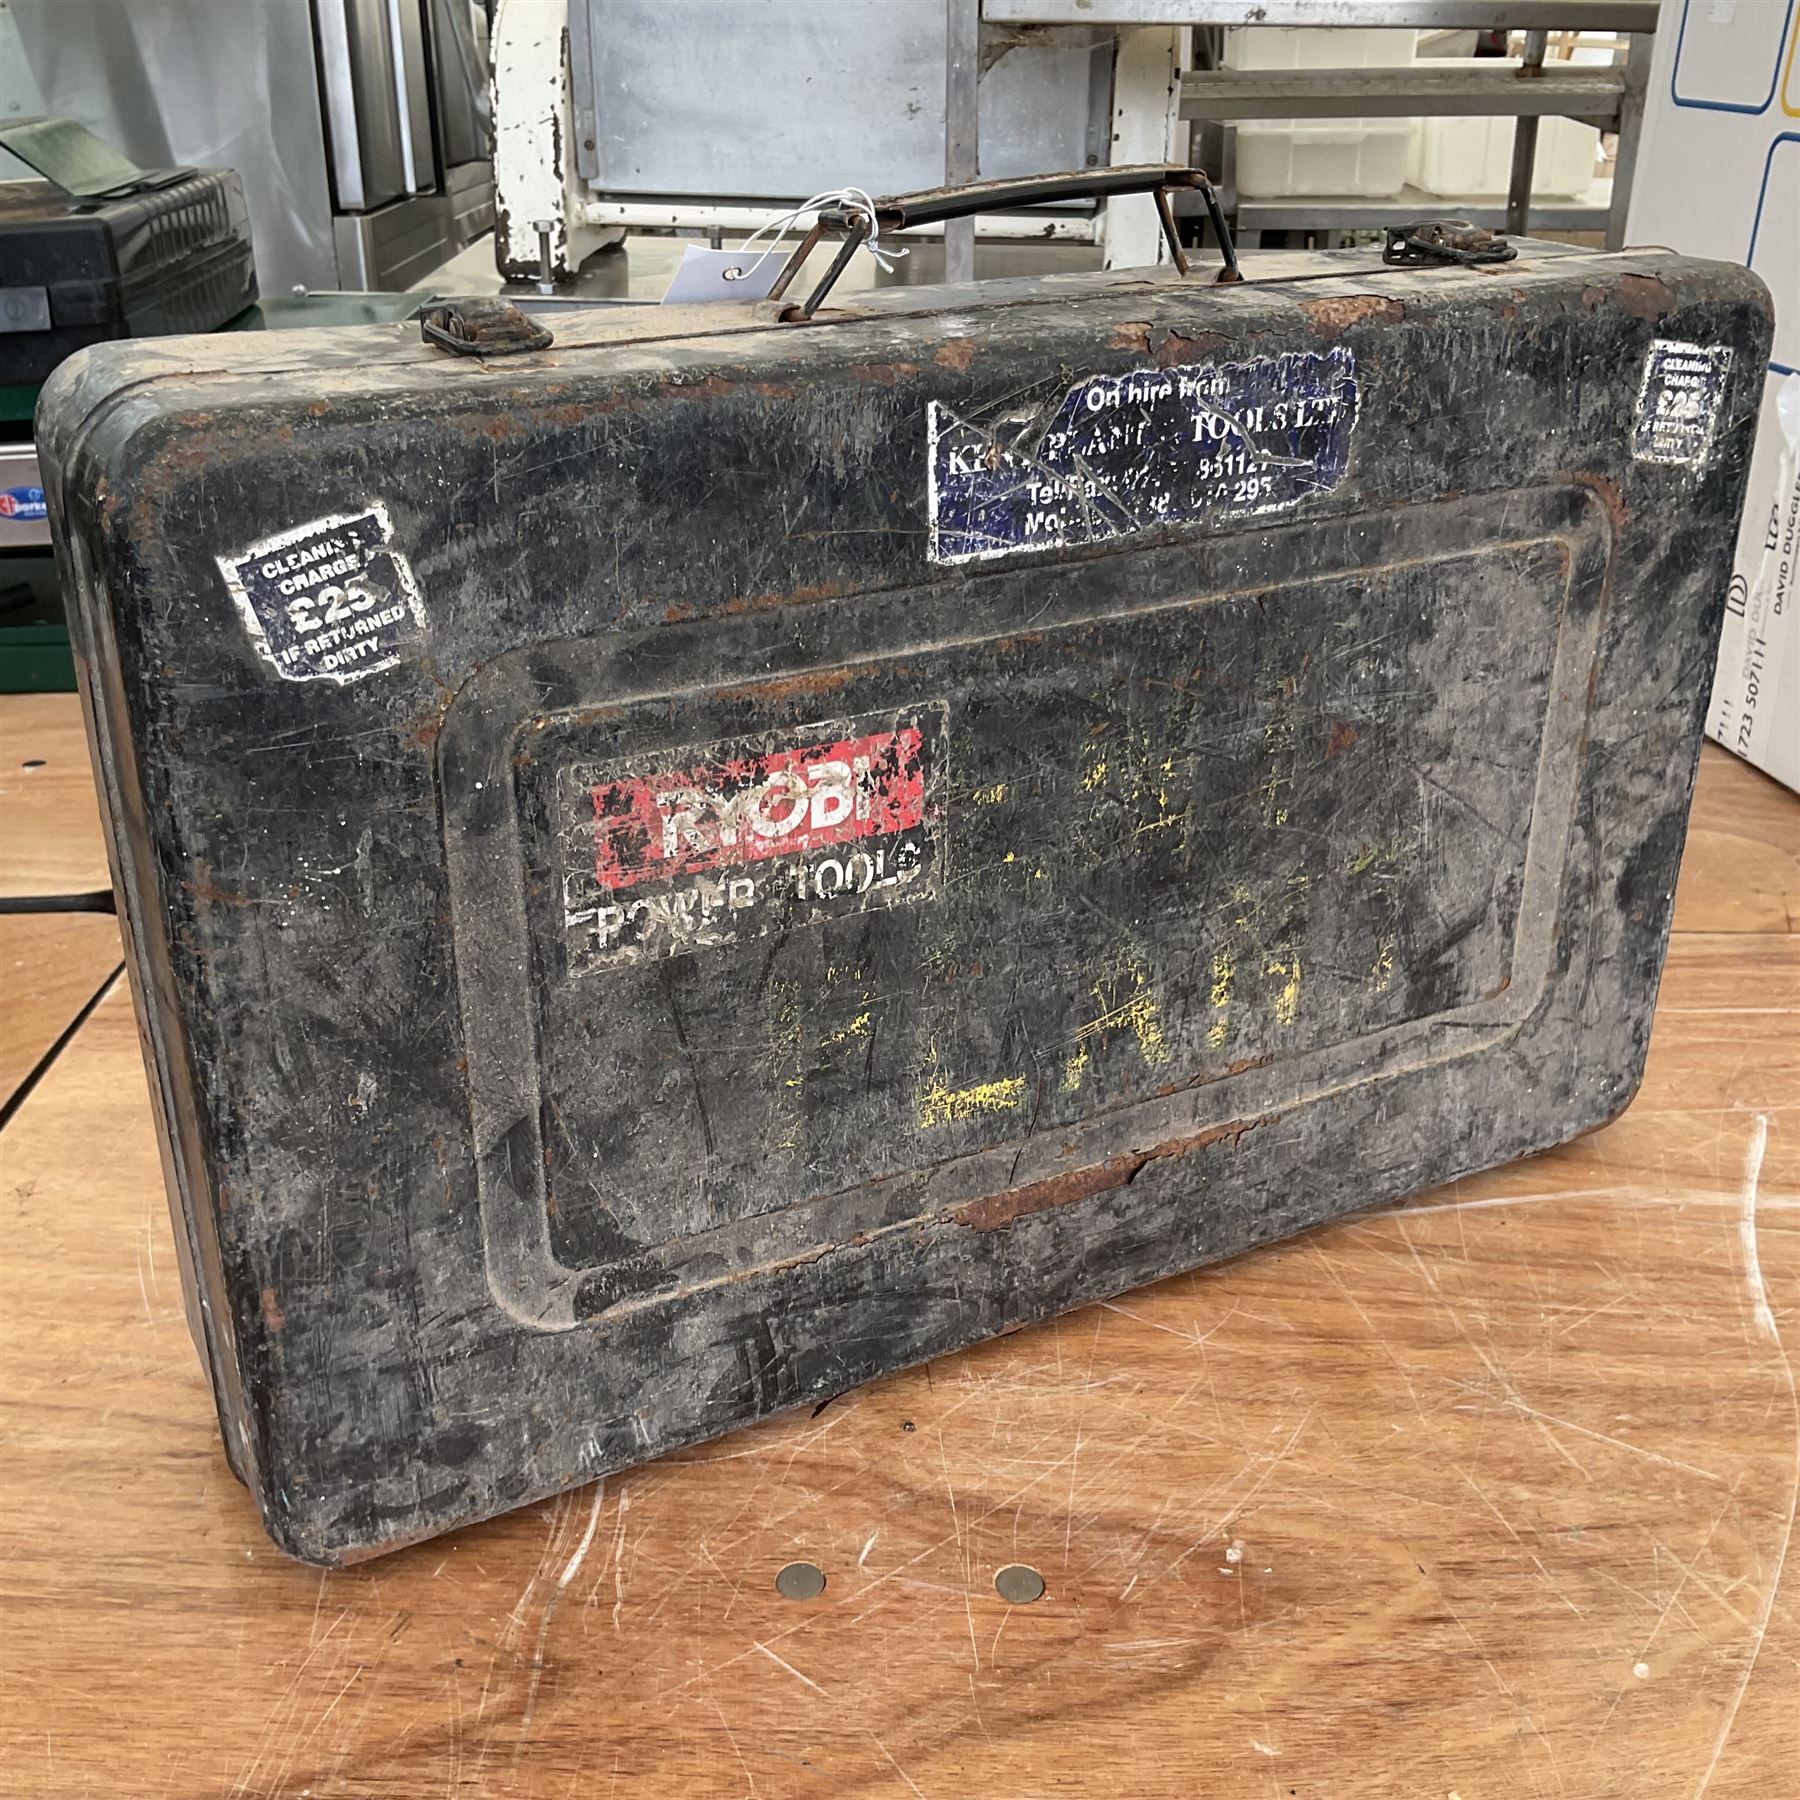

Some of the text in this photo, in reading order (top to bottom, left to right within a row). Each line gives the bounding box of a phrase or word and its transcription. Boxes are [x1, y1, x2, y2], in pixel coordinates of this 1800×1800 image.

[1087, 384, 1120, 413] On
[1128, 381, 1172, 405] hire
[279, 553, 361, 596] CHARGE
[1774, 561, 1789, 616] DAVID
[281, 605, 406, 665] IF RETURNED
[324, 636, 380, 671] DIRTY
[1746, 637, 1766, 709] 507111
[657, 756, 872, 859] RYOBI
